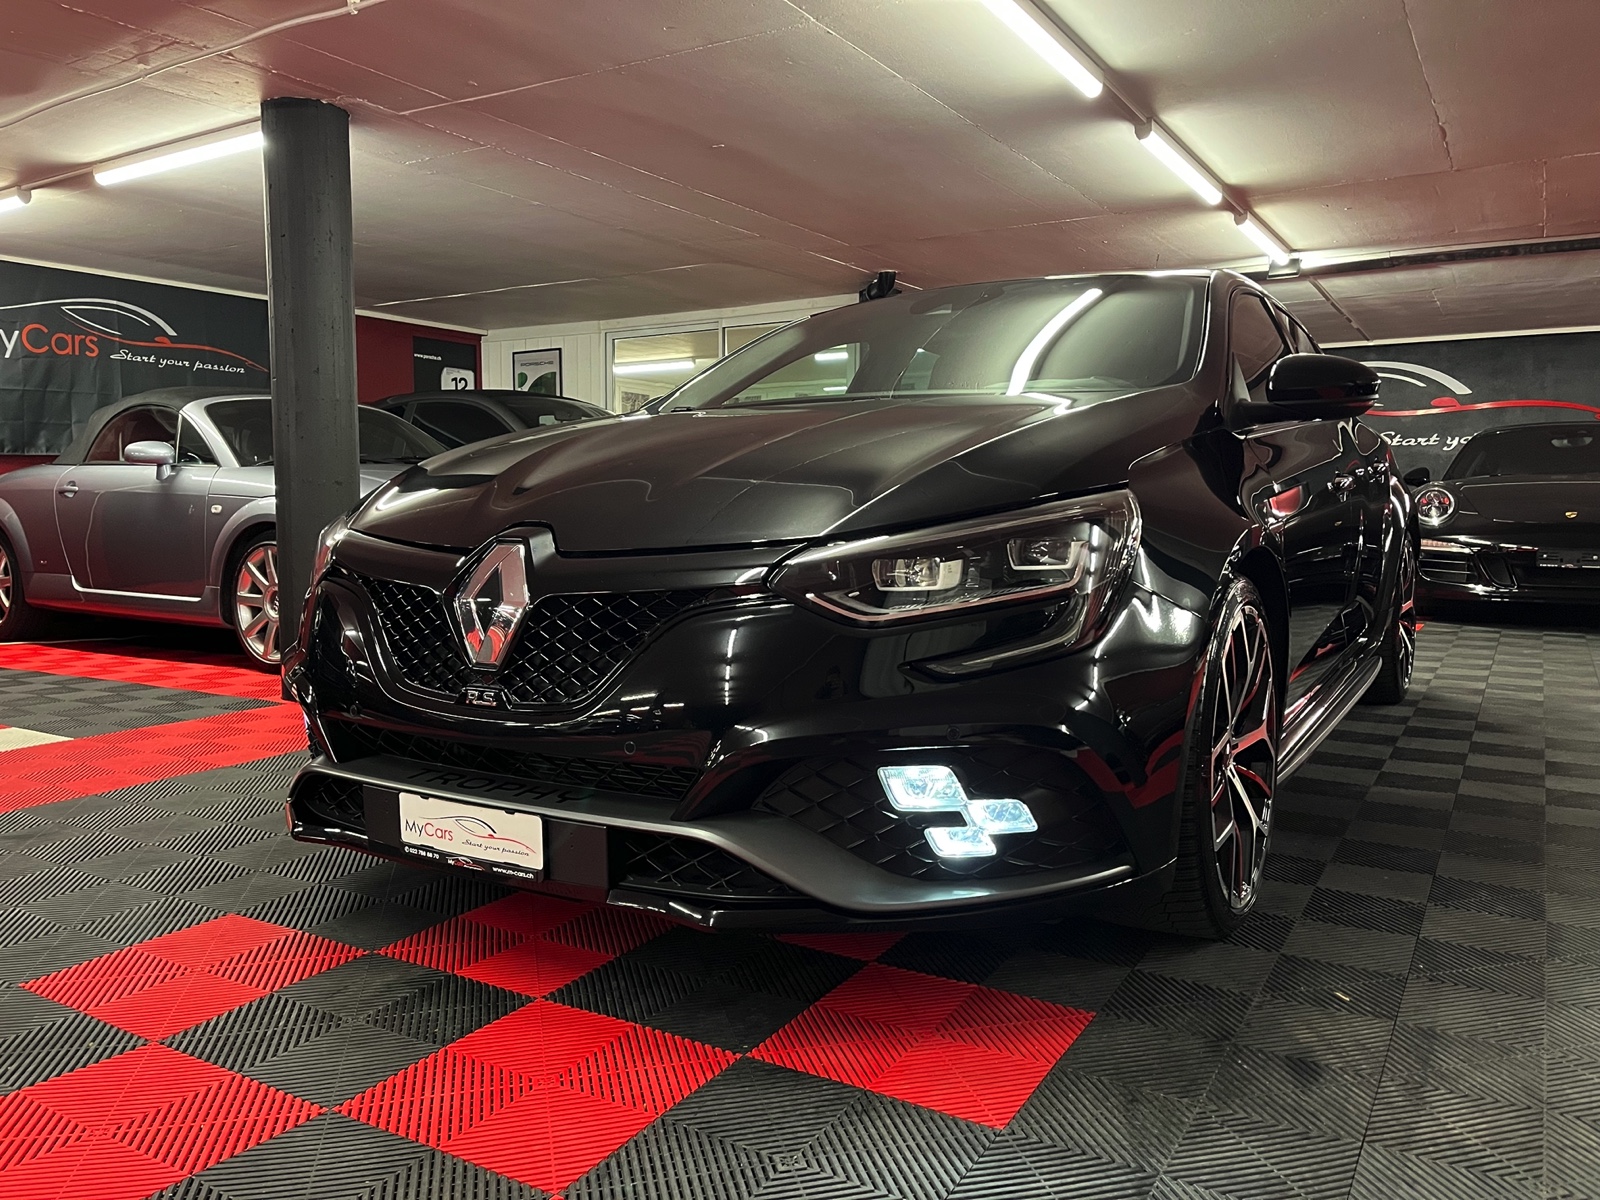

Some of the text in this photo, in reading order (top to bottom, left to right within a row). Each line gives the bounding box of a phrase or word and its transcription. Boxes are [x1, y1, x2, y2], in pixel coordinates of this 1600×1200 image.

[0, 323, 100, 358] yCars
[110, 349, 246, 374] Start your passion
[466, 690, 497, 706] RS
[407, 767, 594, 803] TROPHY
[405, 818, 454, 842] MyCars
[461, 839, 483, 848] Start
[501, 847, 530, 857] passion
